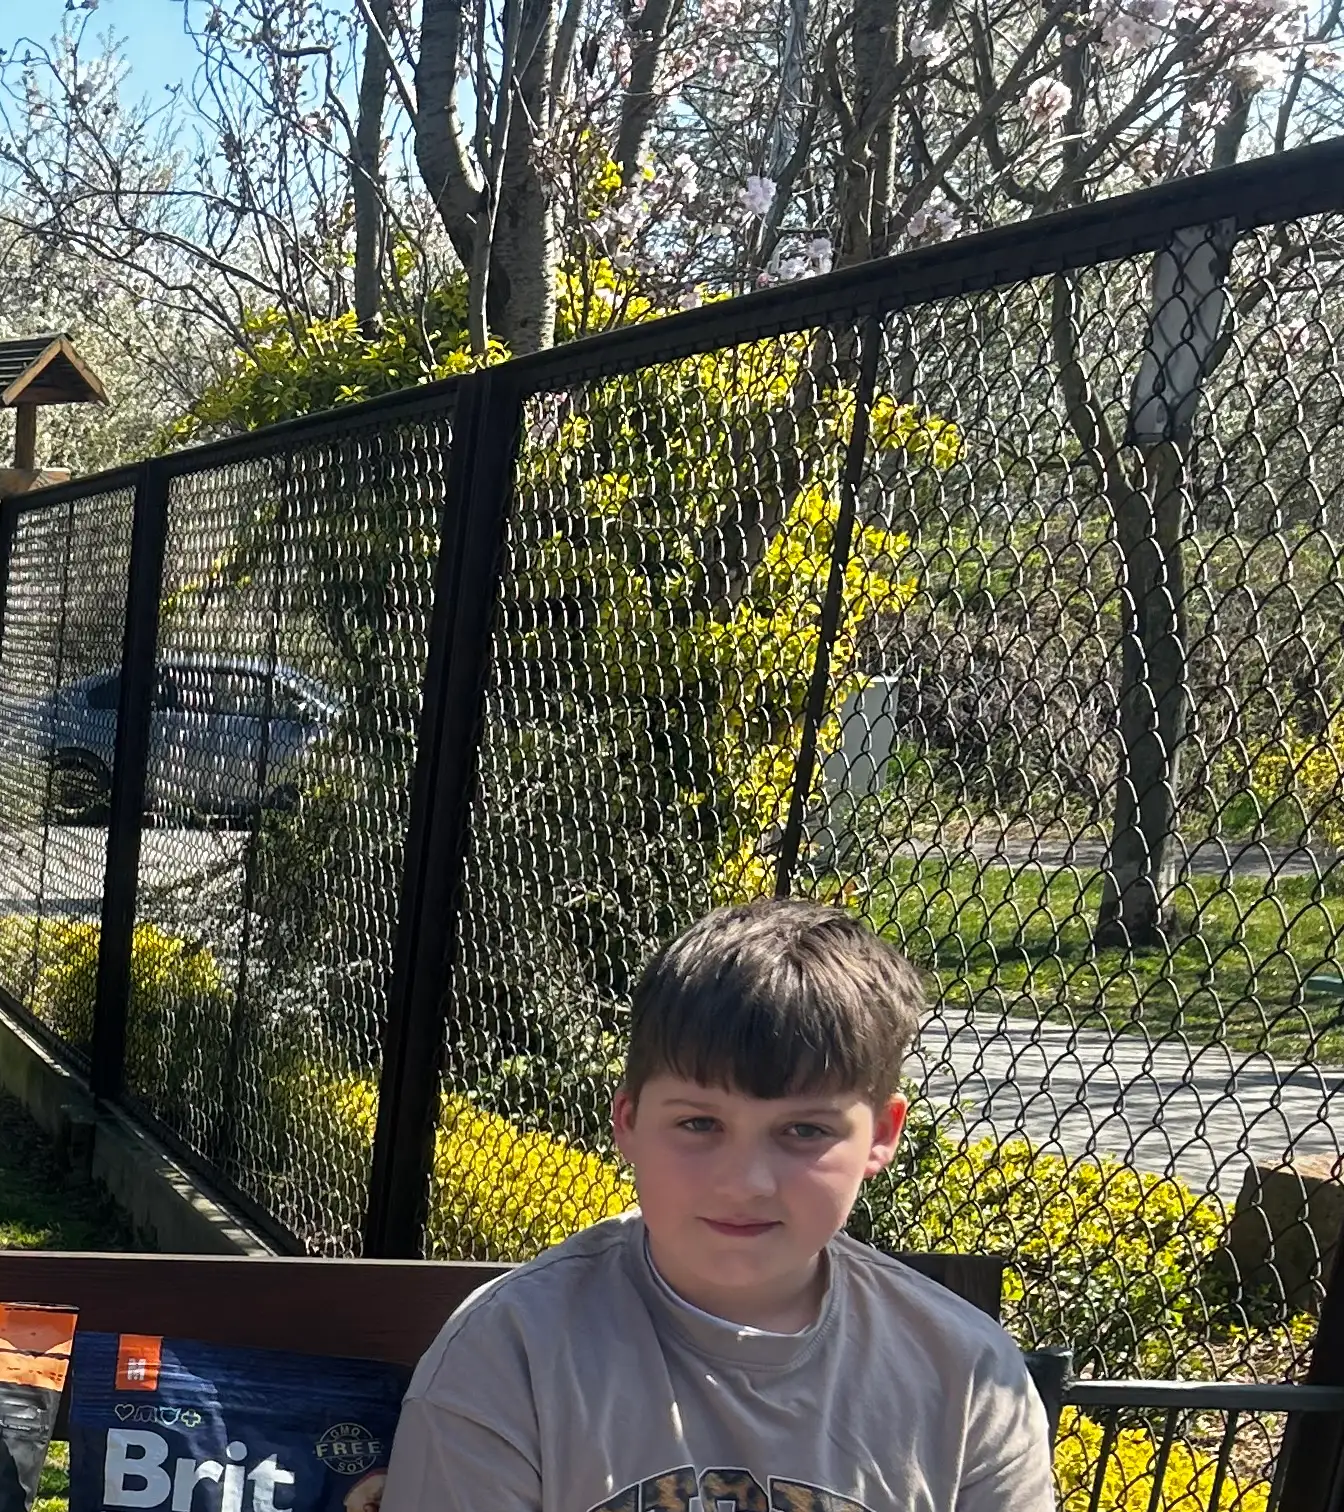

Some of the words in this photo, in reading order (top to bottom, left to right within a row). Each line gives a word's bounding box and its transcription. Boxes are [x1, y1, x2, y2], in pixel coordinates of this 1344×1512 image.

[127, 1357, 145, 1381] M
[329, 1424, 360, 1439] GMO
[316, 1441, 382, 1458] FREE
[336, 1458, 366, 1473] SOY
